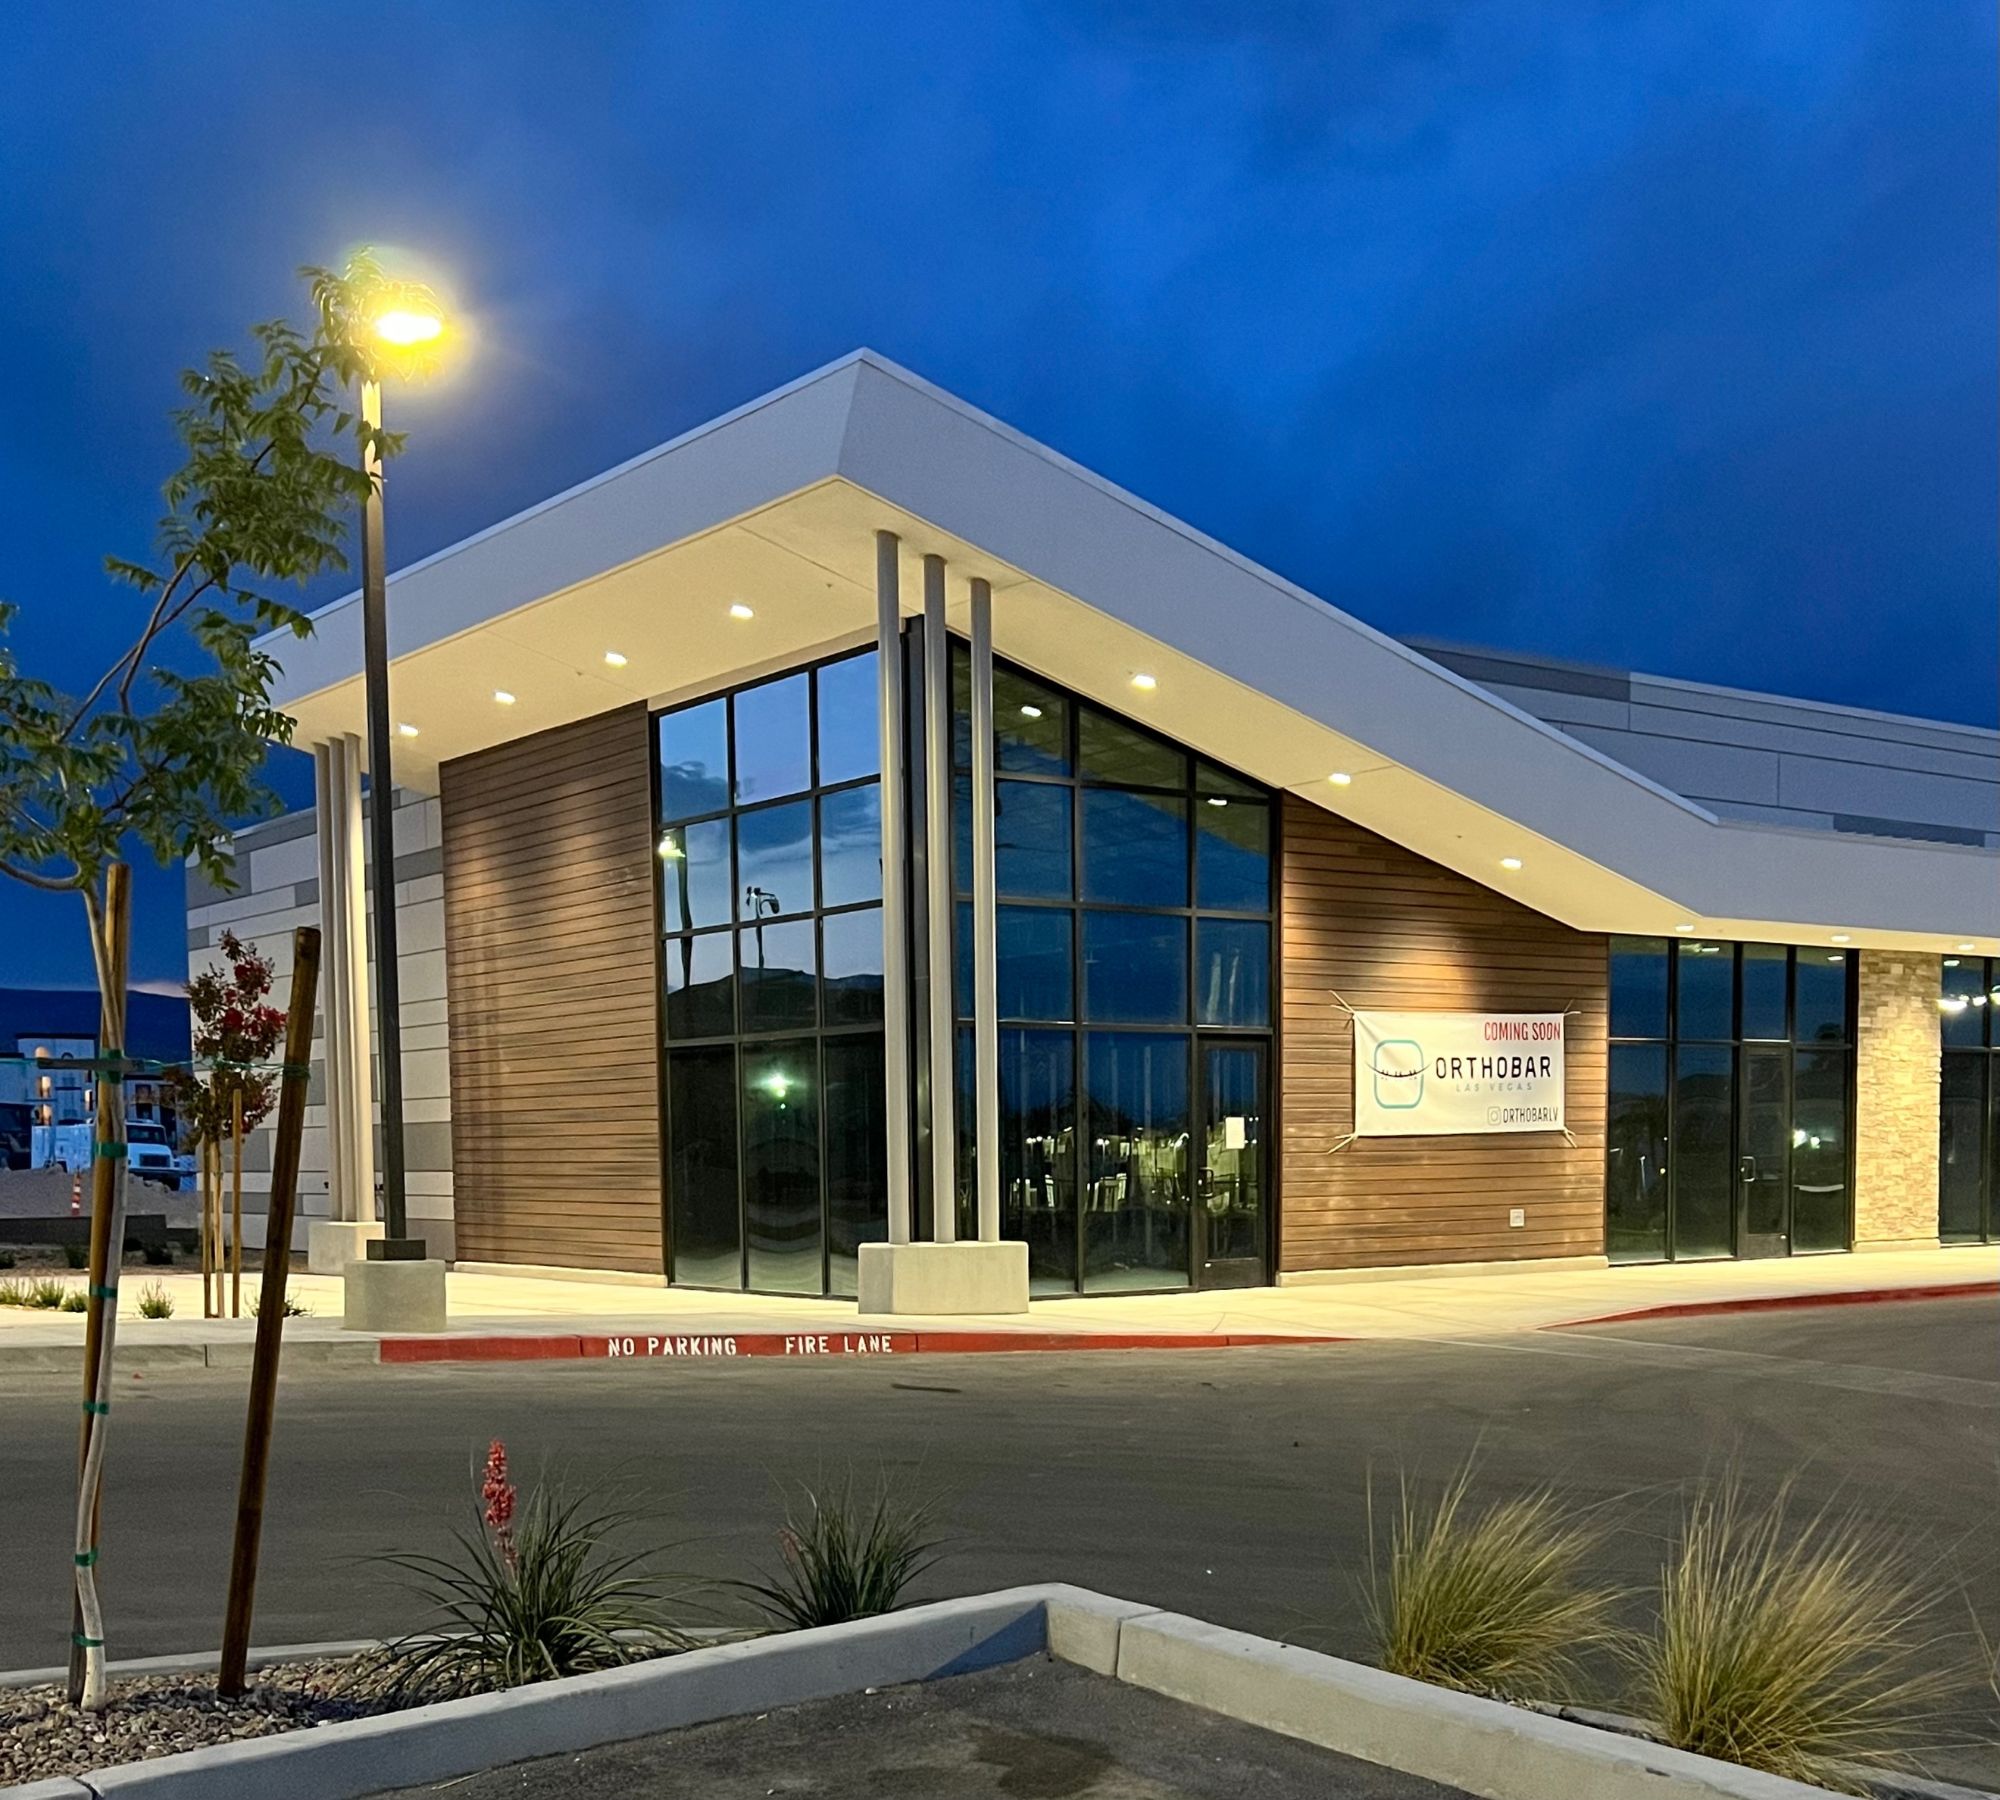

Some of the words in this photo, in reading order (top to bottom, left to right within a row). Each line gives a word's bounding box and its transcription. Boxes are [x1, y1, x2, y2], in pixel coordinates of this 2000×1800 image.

[1484, 1022, 1529, 1041] COMING
[1532, 1022, 1561, 1040] SOON
[1436, 1056, 1551, 1079] ORTHOBAR
[1456, 1083, 1480, 1092] LAS
[1489, 1082, 1532, 1091] VEGAS
[1503, 1107, 1558, 1123] ORTHOBARLV
[607, 1337, 635, 1357] NO
[648, 1336, 737, 1356] PARKING
[785, 1336, 830, 1354] FIRE
[844, 1335, 893, 1353] LANE
